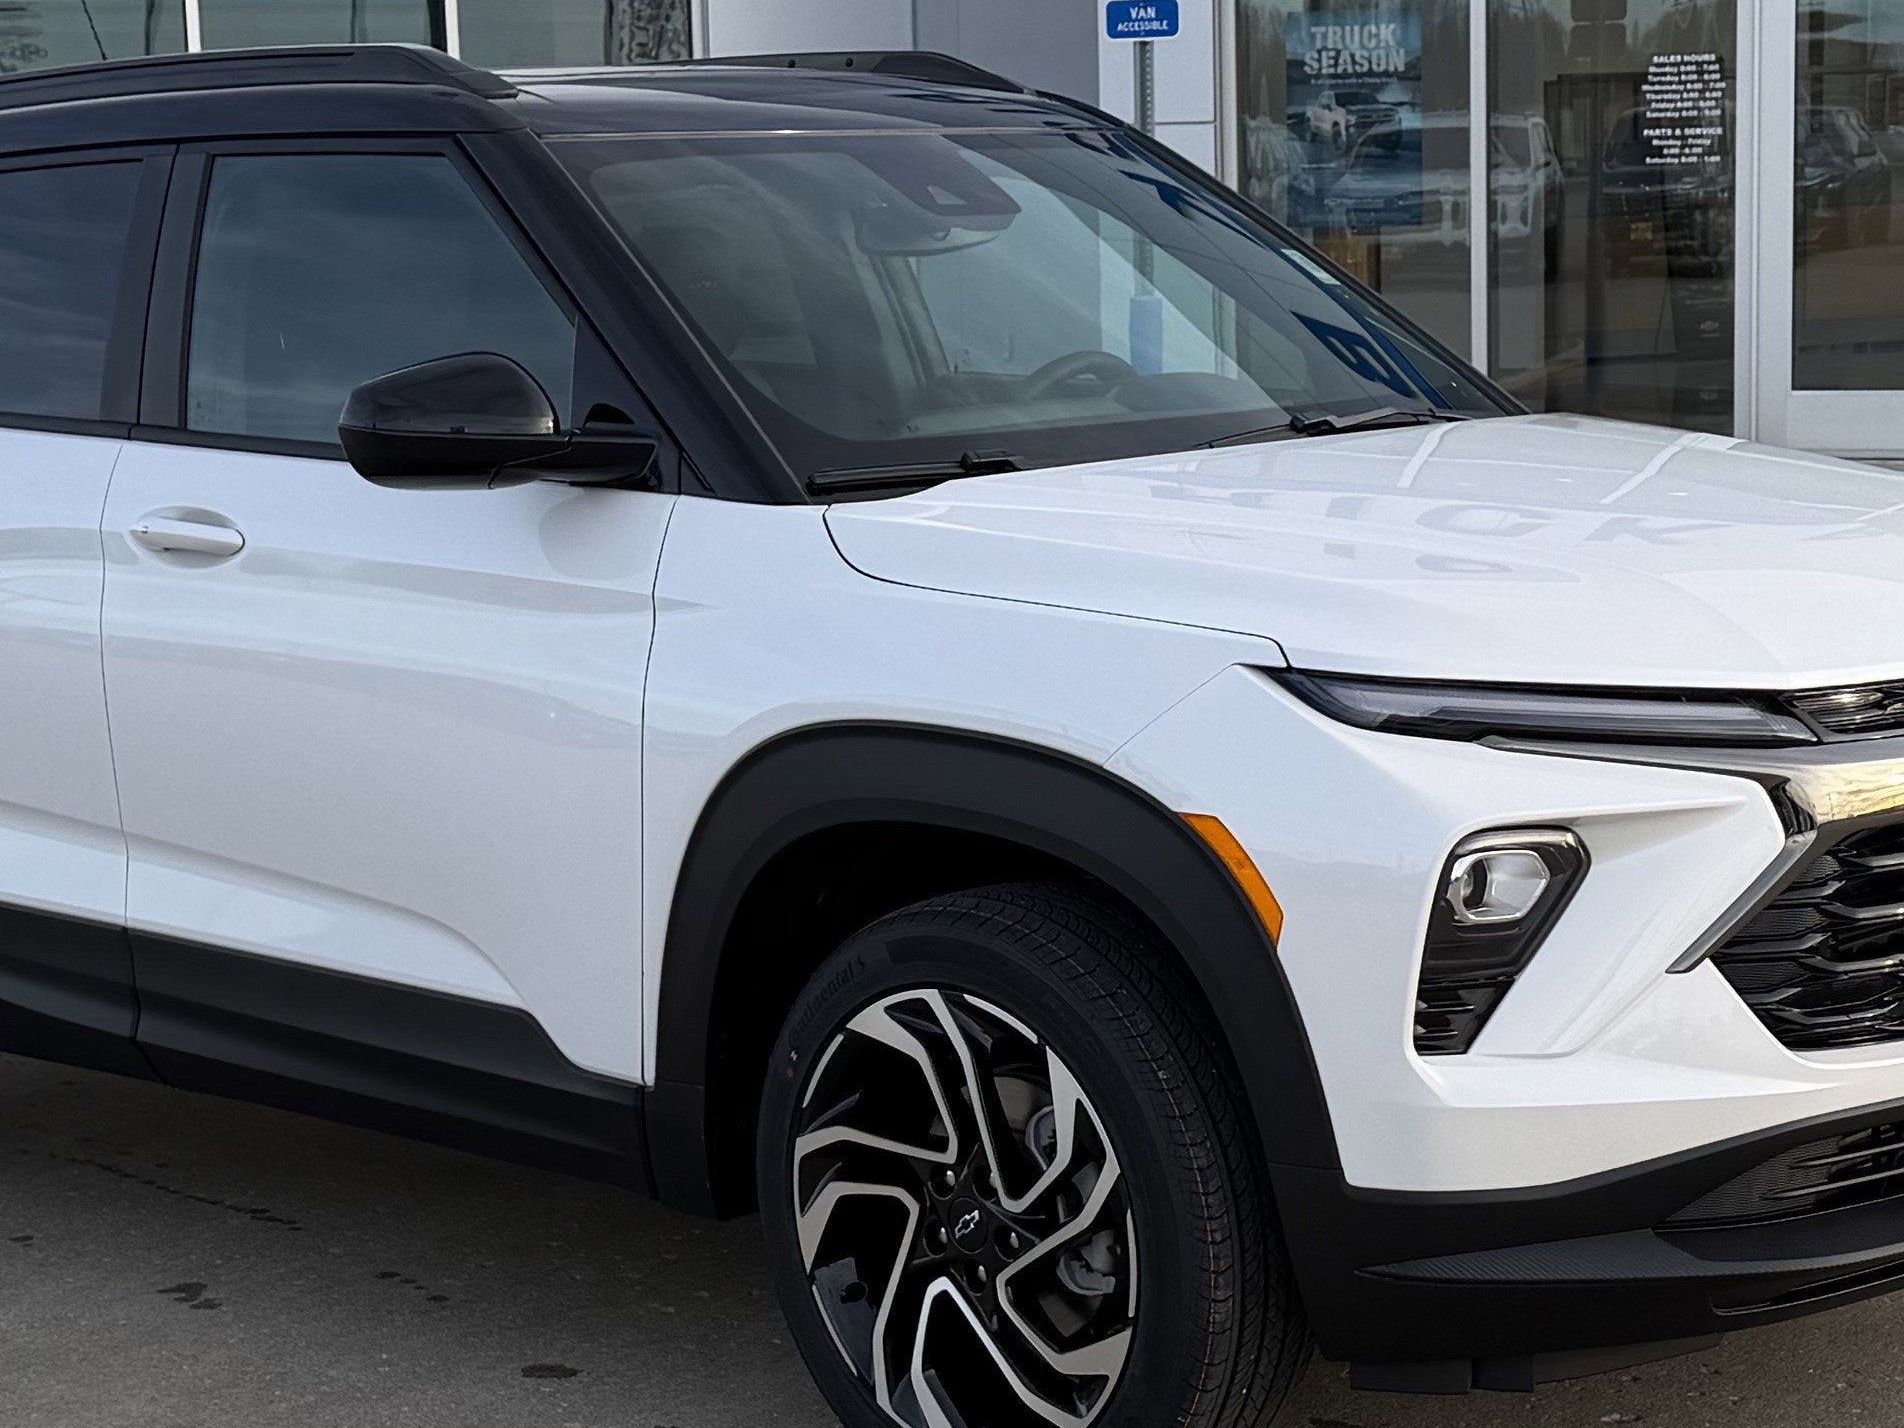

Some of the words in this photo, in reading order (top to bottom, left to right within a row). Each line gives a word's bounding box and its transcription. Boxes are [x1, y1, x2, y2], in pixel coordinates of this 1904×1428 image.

[1129, 6, 1156, 20] VAN
[1117, 20, 1169, 32] ACCESSIBLE
[1310, 24, 1396, 50] TRUCK
[1303, 48, 1406, 74] SEASON
[1652, 54, 1682, 63] SALES
[1683, 53, 1716, 62] HOURS
[1642, 128, 1672, 137] PARTS
[1684, 126, 1723, 136] SERVICE
